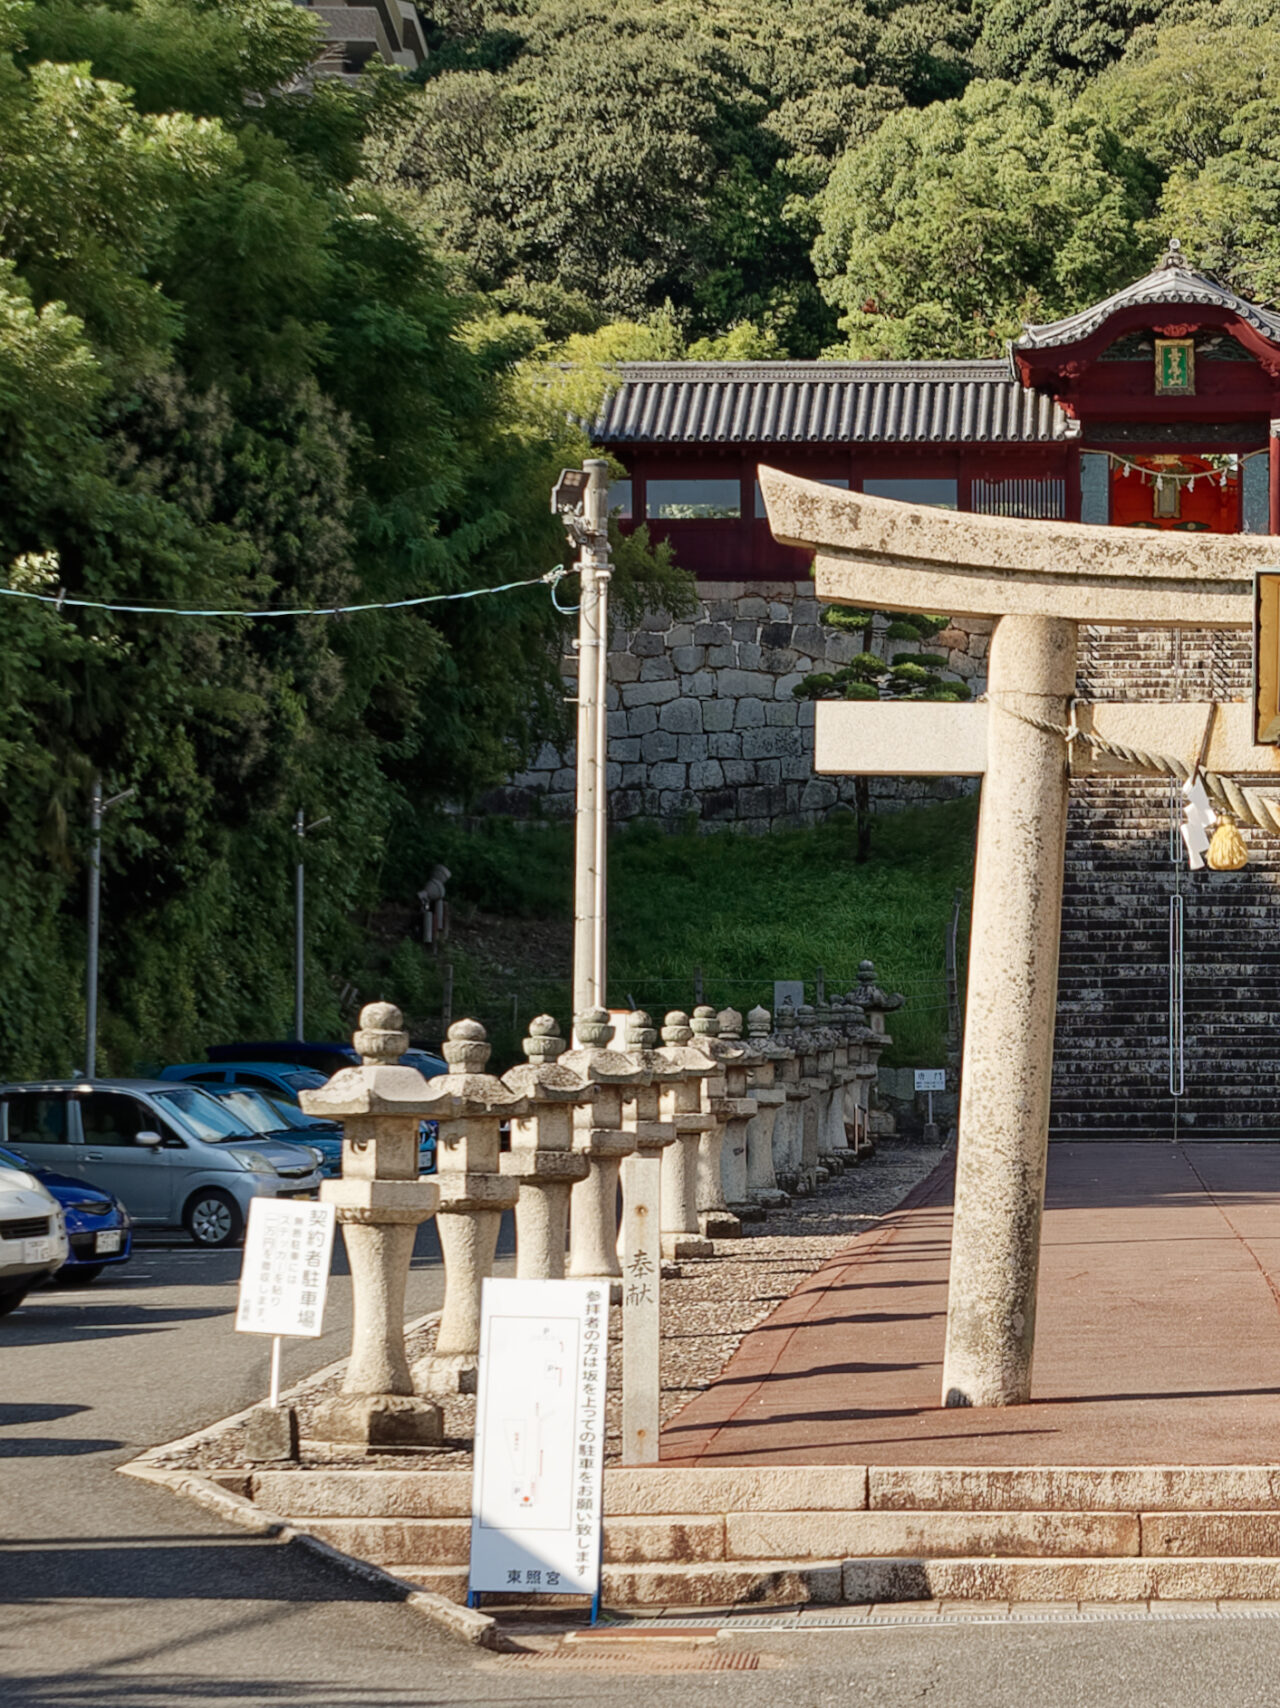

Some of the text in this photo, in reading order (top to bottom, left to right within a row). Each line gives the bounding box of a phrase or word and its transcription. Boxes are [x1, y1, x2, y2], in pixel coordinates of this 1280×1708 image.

[297, 1208, 329, 1329] 契約者駐車場
[626, 1248, 655, 1307] 奉献
[575, 1290, 602, 1577] 参拝者の方は坂を上っての駐車をお願い致します
[506, 1569, 561, 1586] 東照宮
